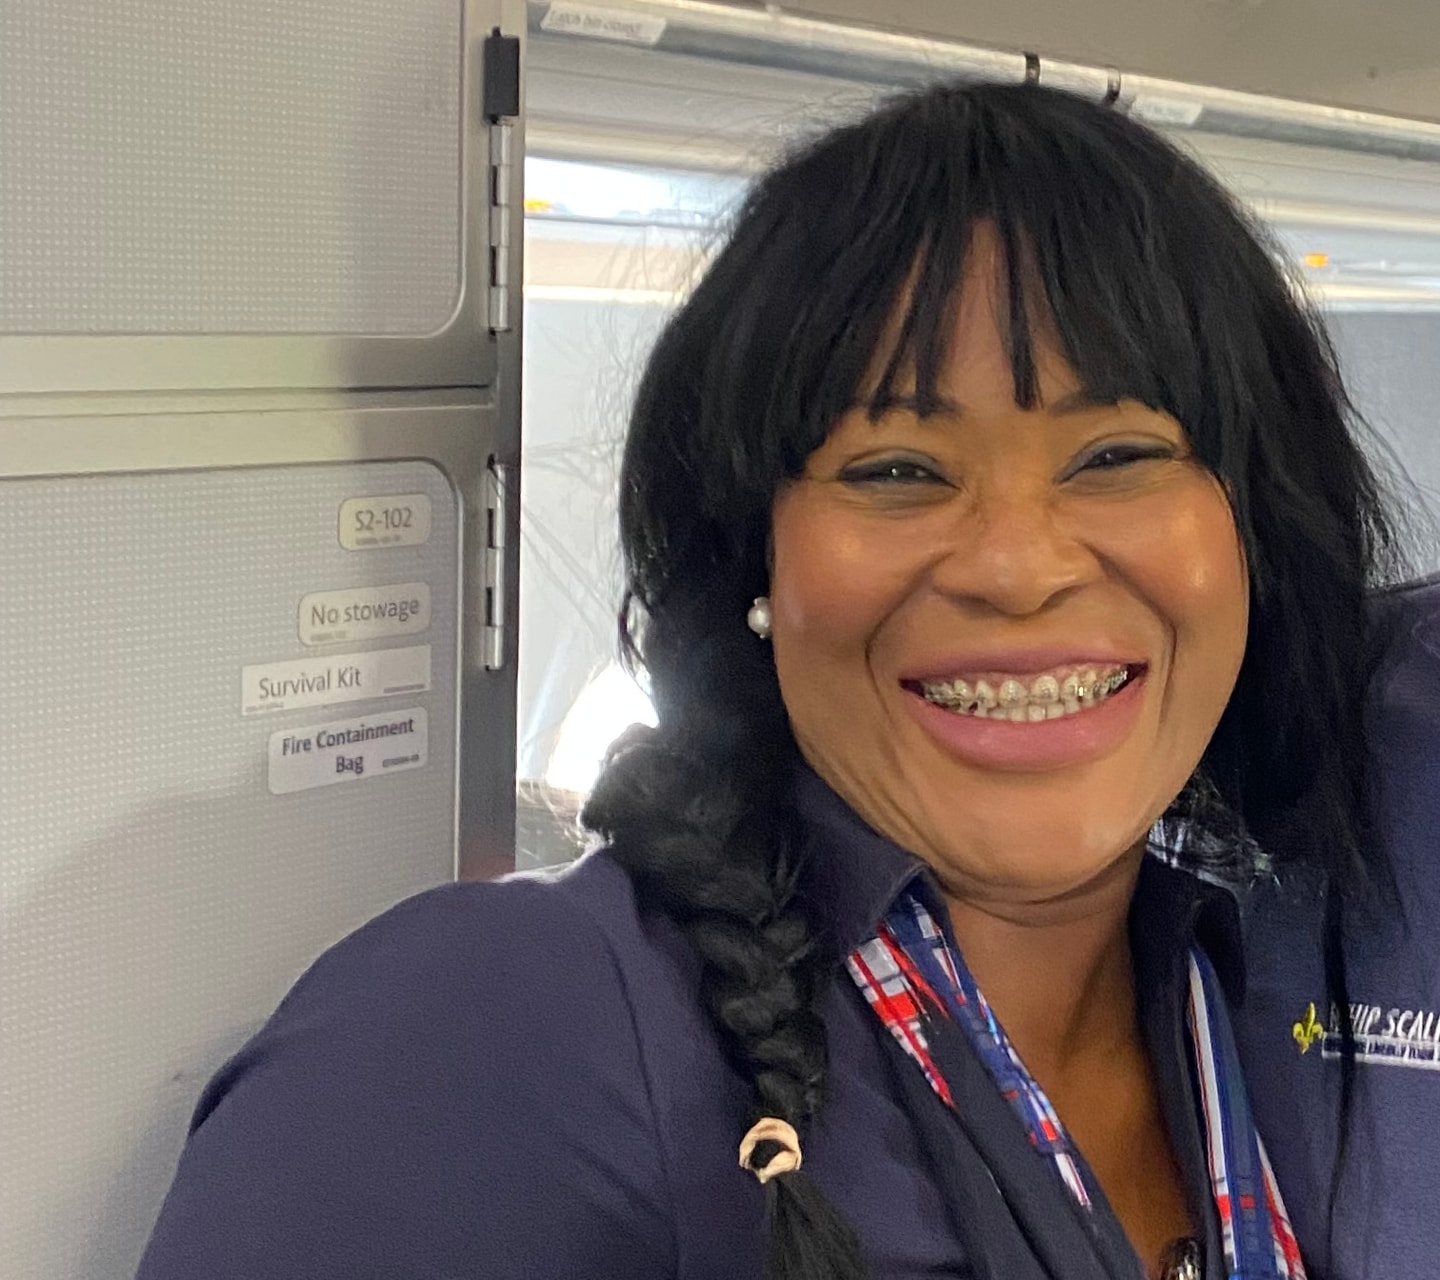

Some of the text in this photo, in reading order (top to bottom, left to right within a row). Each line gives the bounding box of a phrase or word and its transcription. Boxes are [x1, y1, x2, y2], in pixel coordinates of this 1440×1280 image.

[355, 507, 413, 532] S2-102
[311, 599, 420, 626] No stowage
[259, 669, 331, 700] Survival
[337, 666, 362, 689] Kit
[282, 718, 415, 756] Fire Containment
[335, 755, 364, 775] Bag
